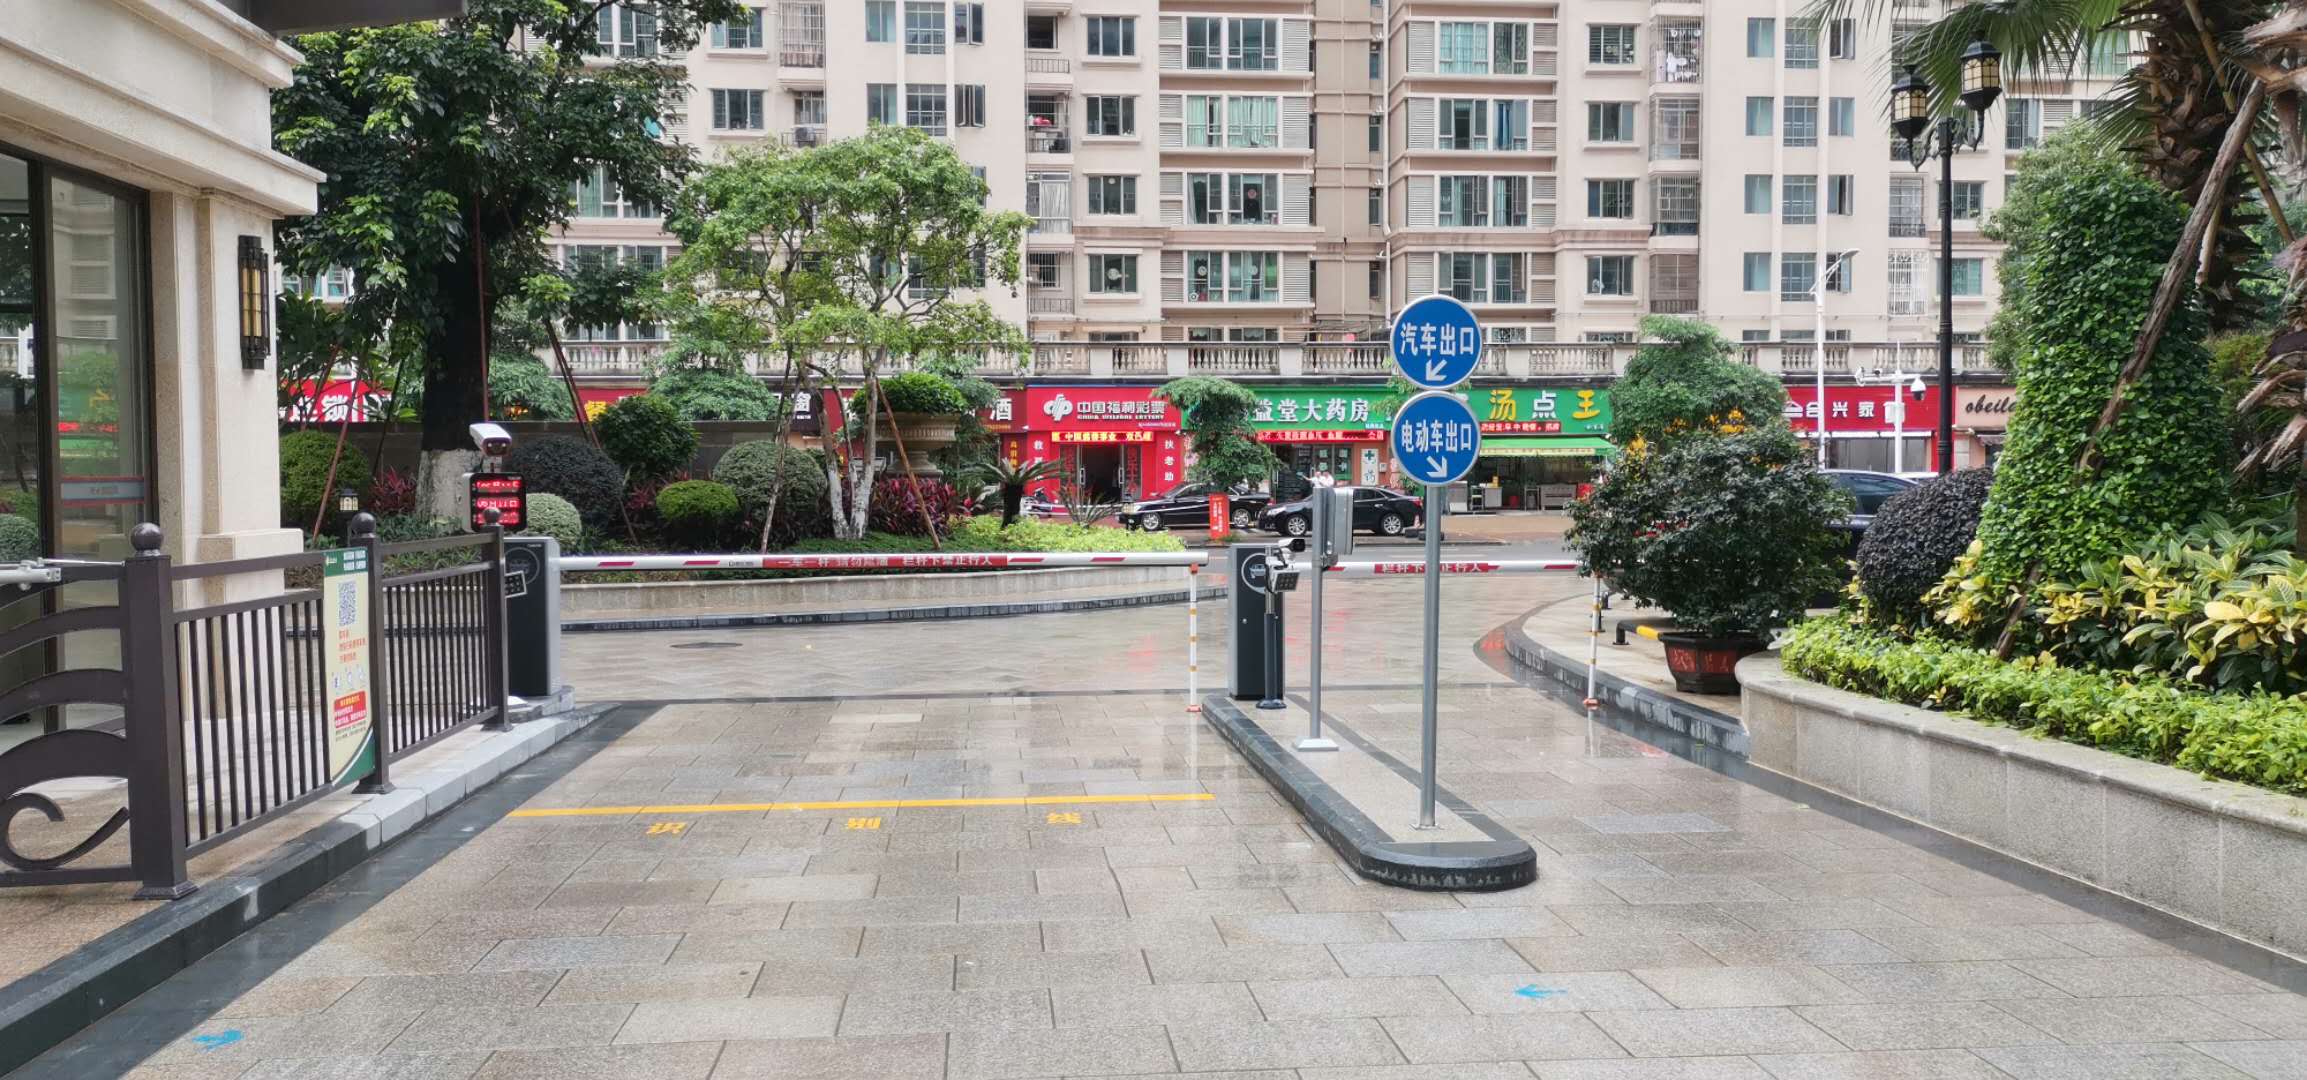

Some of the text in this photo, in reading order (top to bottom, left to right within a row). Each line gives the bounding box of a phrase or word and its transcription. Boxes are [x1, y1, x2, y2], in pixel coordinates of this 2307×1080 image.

[1400, 322, 1474, 356] 汽车出口
[1077, 401, 1166, 414] 中国福利彩票
[1488, 388, 1600, 420] 汤点王
[1401, 419, 1472, 453] 电动车出口
[1382, 563, 1482, 573] 栏杆下止行人
